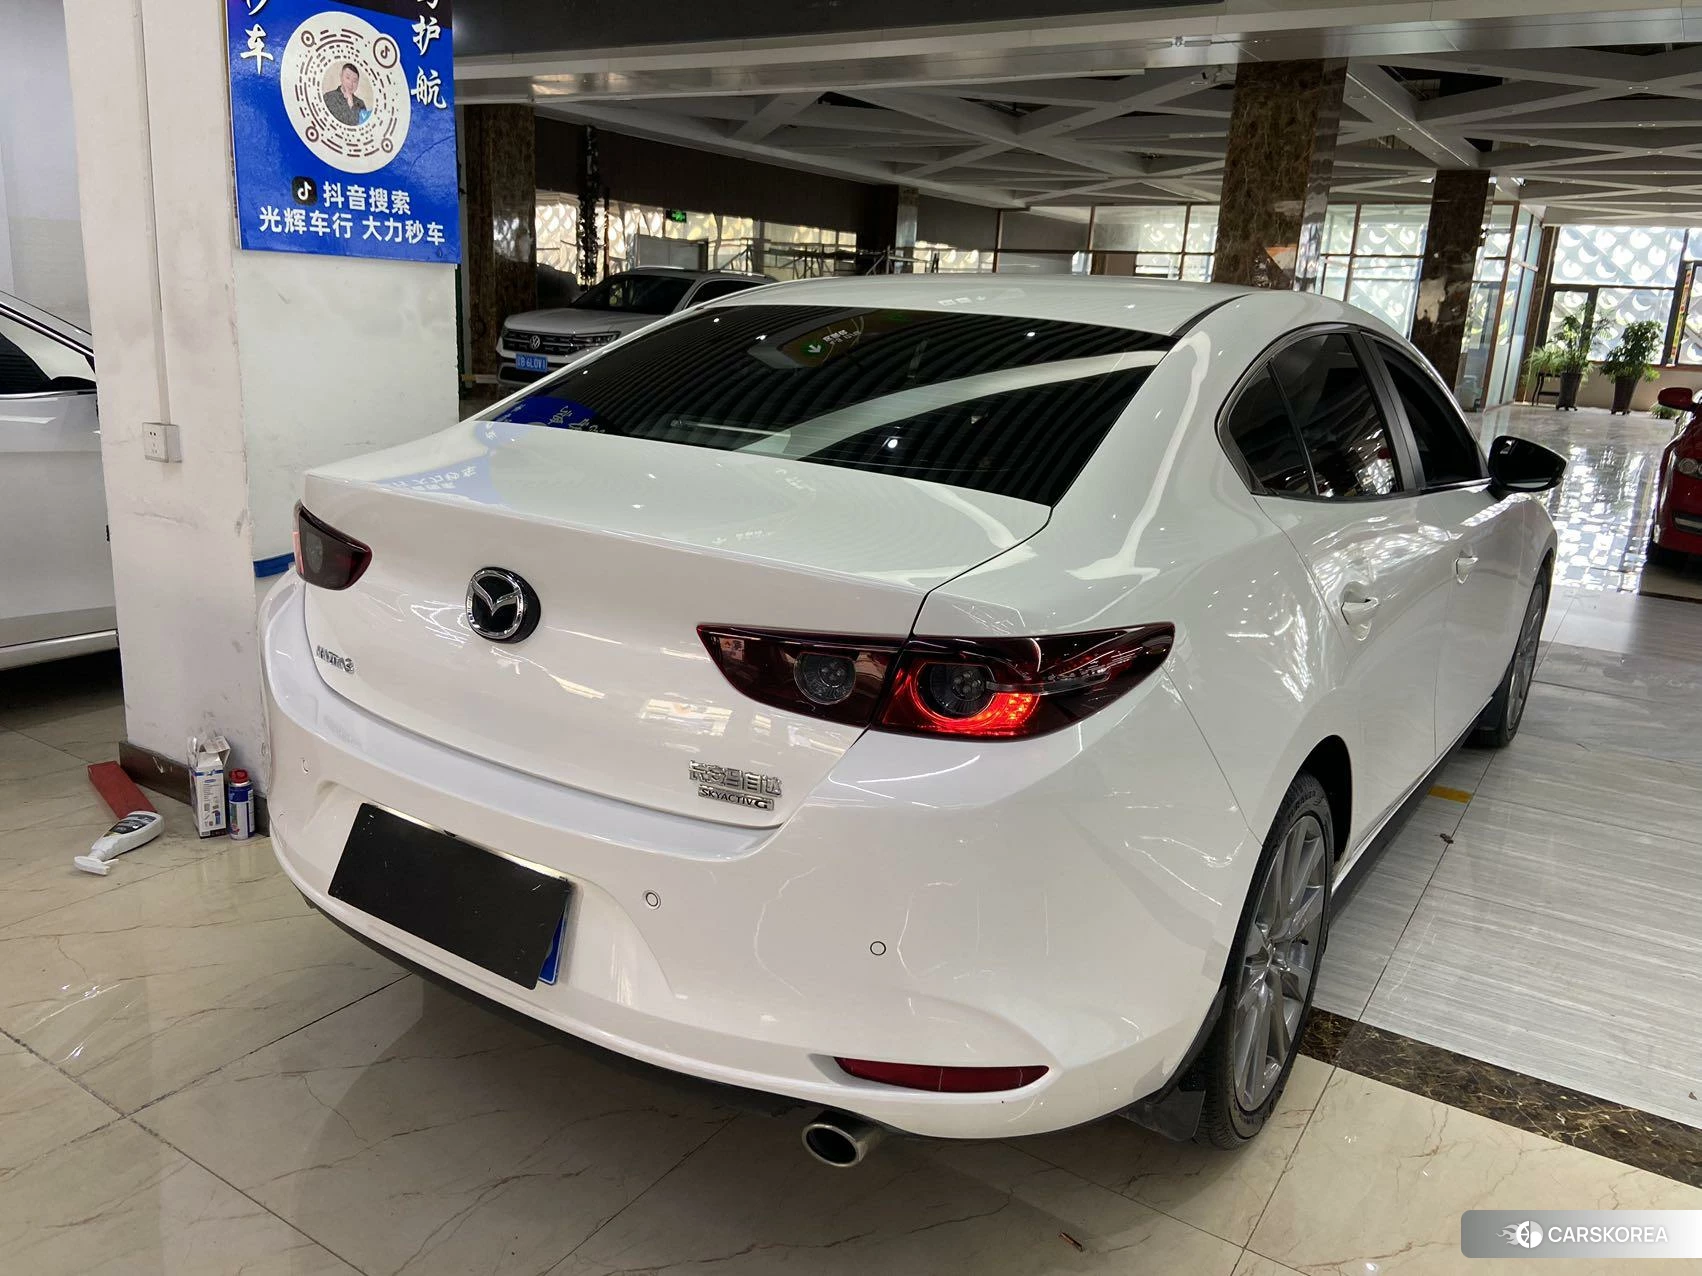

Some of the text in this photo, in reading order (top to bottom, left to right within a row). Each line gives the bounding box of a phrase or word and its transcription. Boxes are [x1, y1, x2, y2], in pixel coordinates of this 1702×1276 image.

[323, 182, 411, 216] 抖音搜索
[259, 206, 446, 246] 光辉车行 大力秒车
